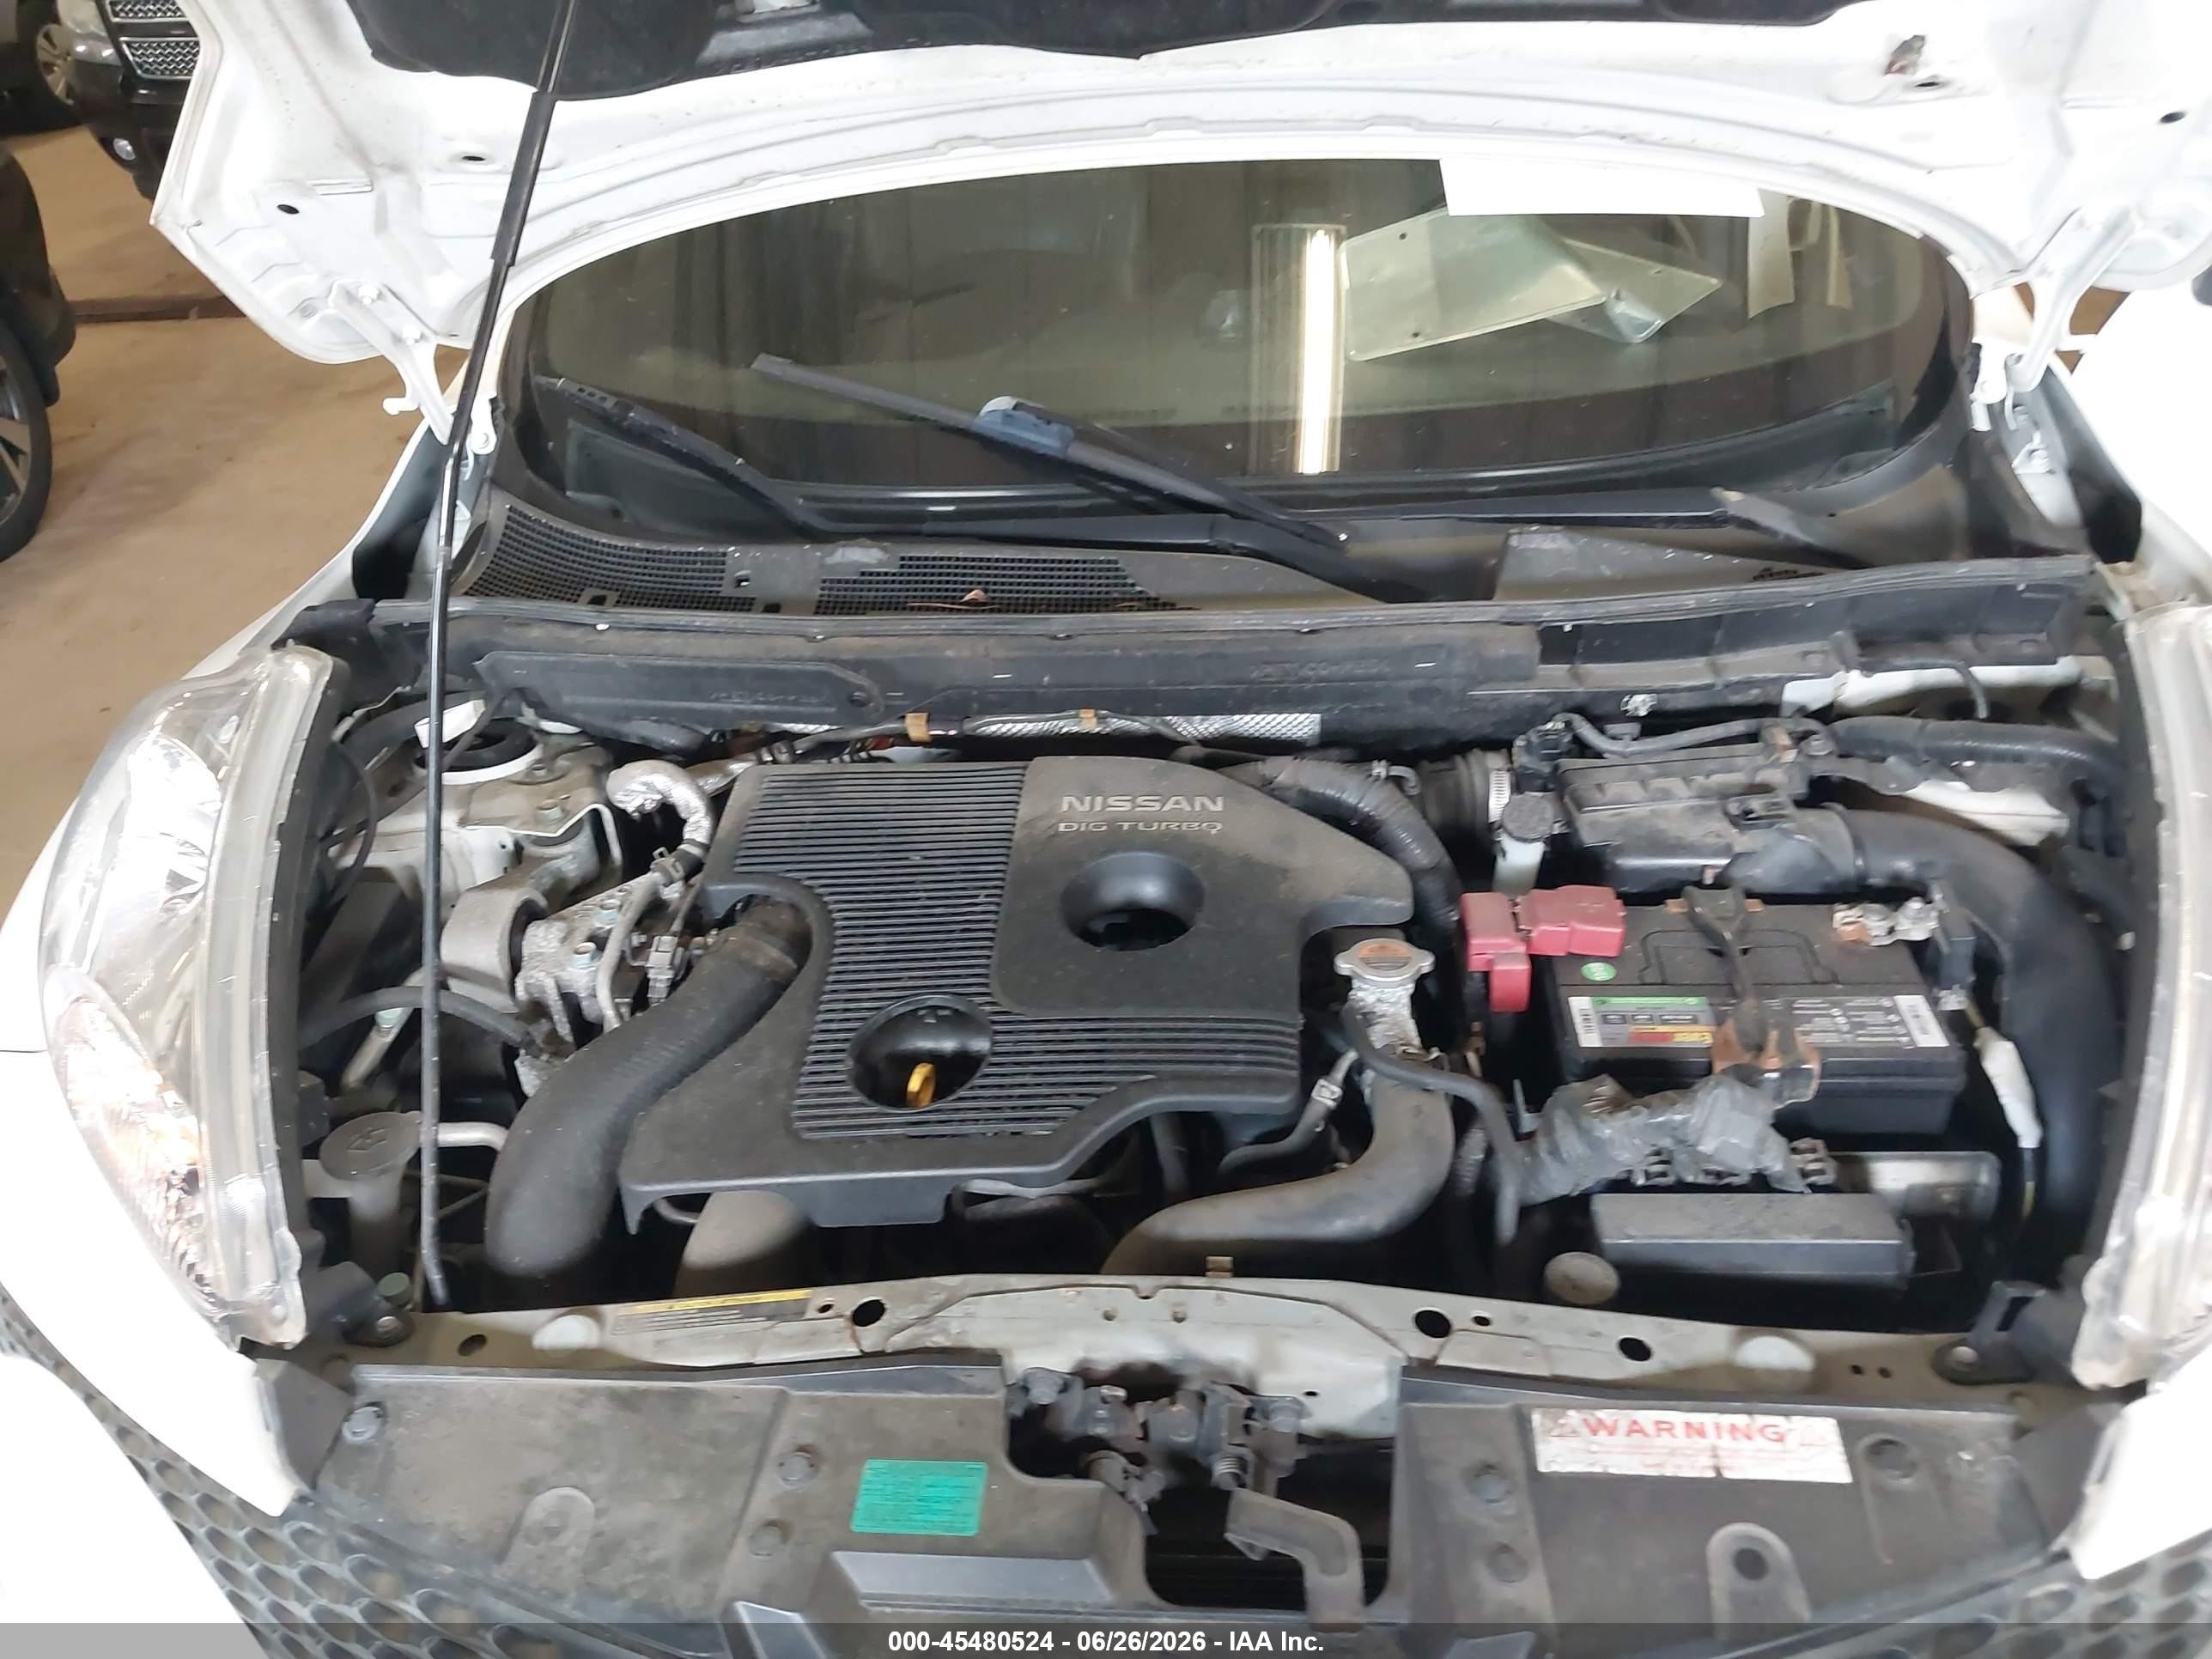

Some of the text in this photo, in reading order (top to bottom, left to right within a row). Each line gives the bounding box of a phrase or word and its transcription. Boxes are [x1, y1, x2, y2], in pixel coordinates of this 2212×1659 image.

[1060, 795, 1224, 811] NISSAN
[1057, 822, 1108, 832] DIG
[1582, 1417, 1786, 1443] WARNING
